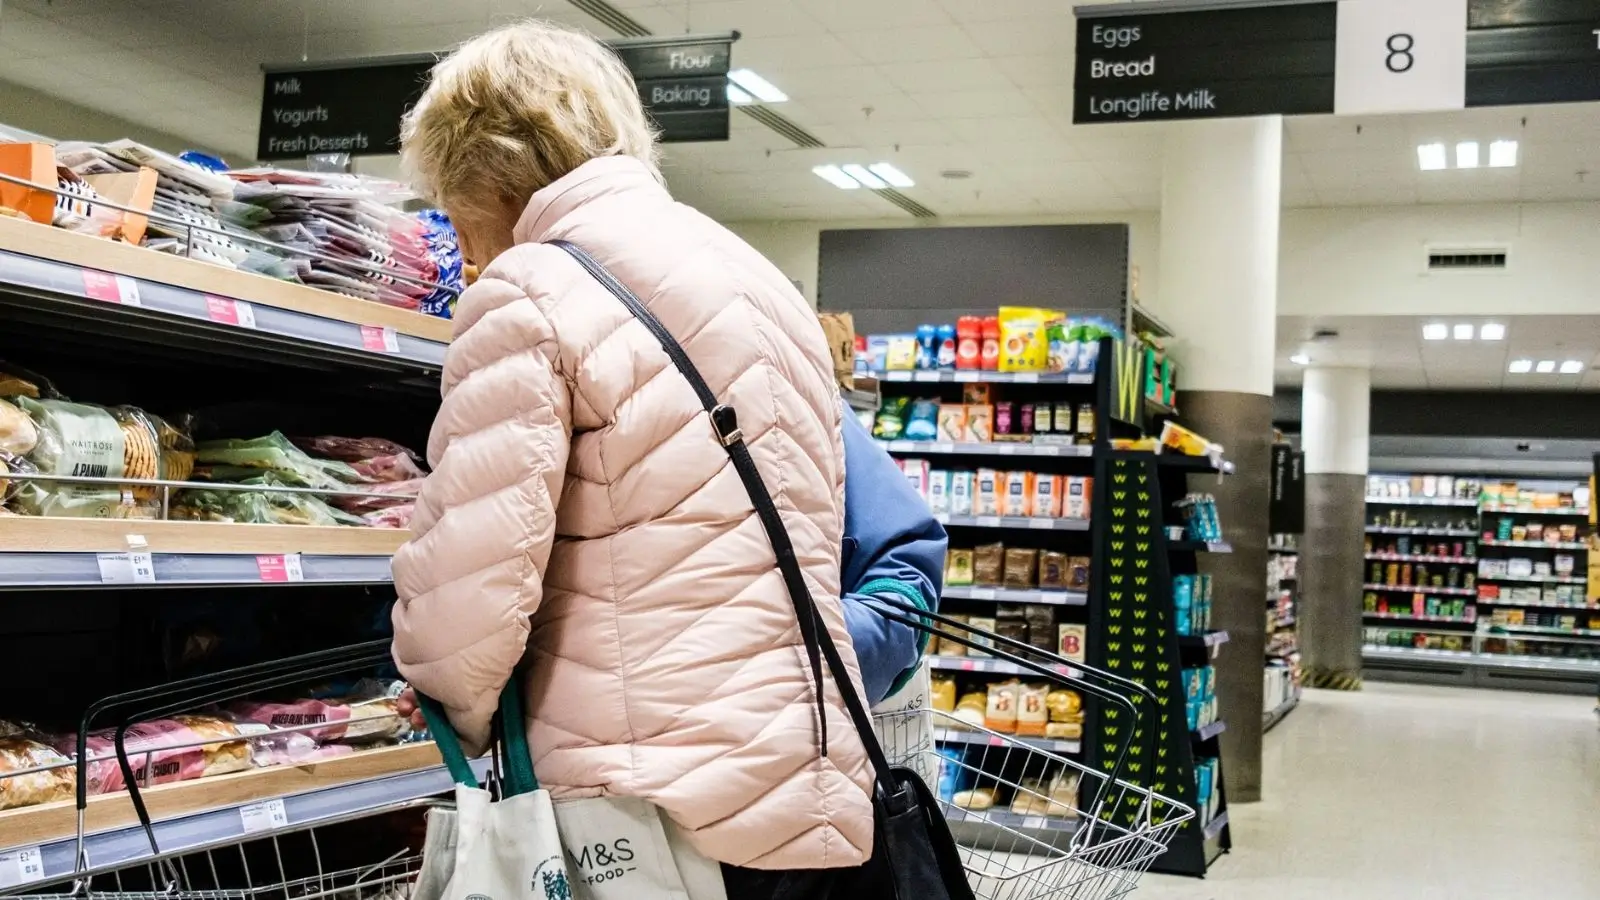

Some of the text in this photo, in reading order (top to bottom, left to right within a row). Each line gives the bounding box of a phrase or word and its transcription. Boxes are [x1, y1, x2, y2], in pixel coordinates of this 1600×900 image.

[1092, 25, 1141, 48] Eggs
[669, 52, 714, 69] Flour
[1386, 33, 1414, 73] 8
[1091, 55, 1155, 78] Bread
[274, 78, 301, 95] Milk
[652, 84, 710, 106] Baking
[1089, 88, 1216, 118] Longlife Milk
[273, 105, 328, 128] Yogurts
[268, 132, 368, 152] Fresh Desserts
[1116, 339, 1142, 425] W
[567, 838, 634, 870] M&S
